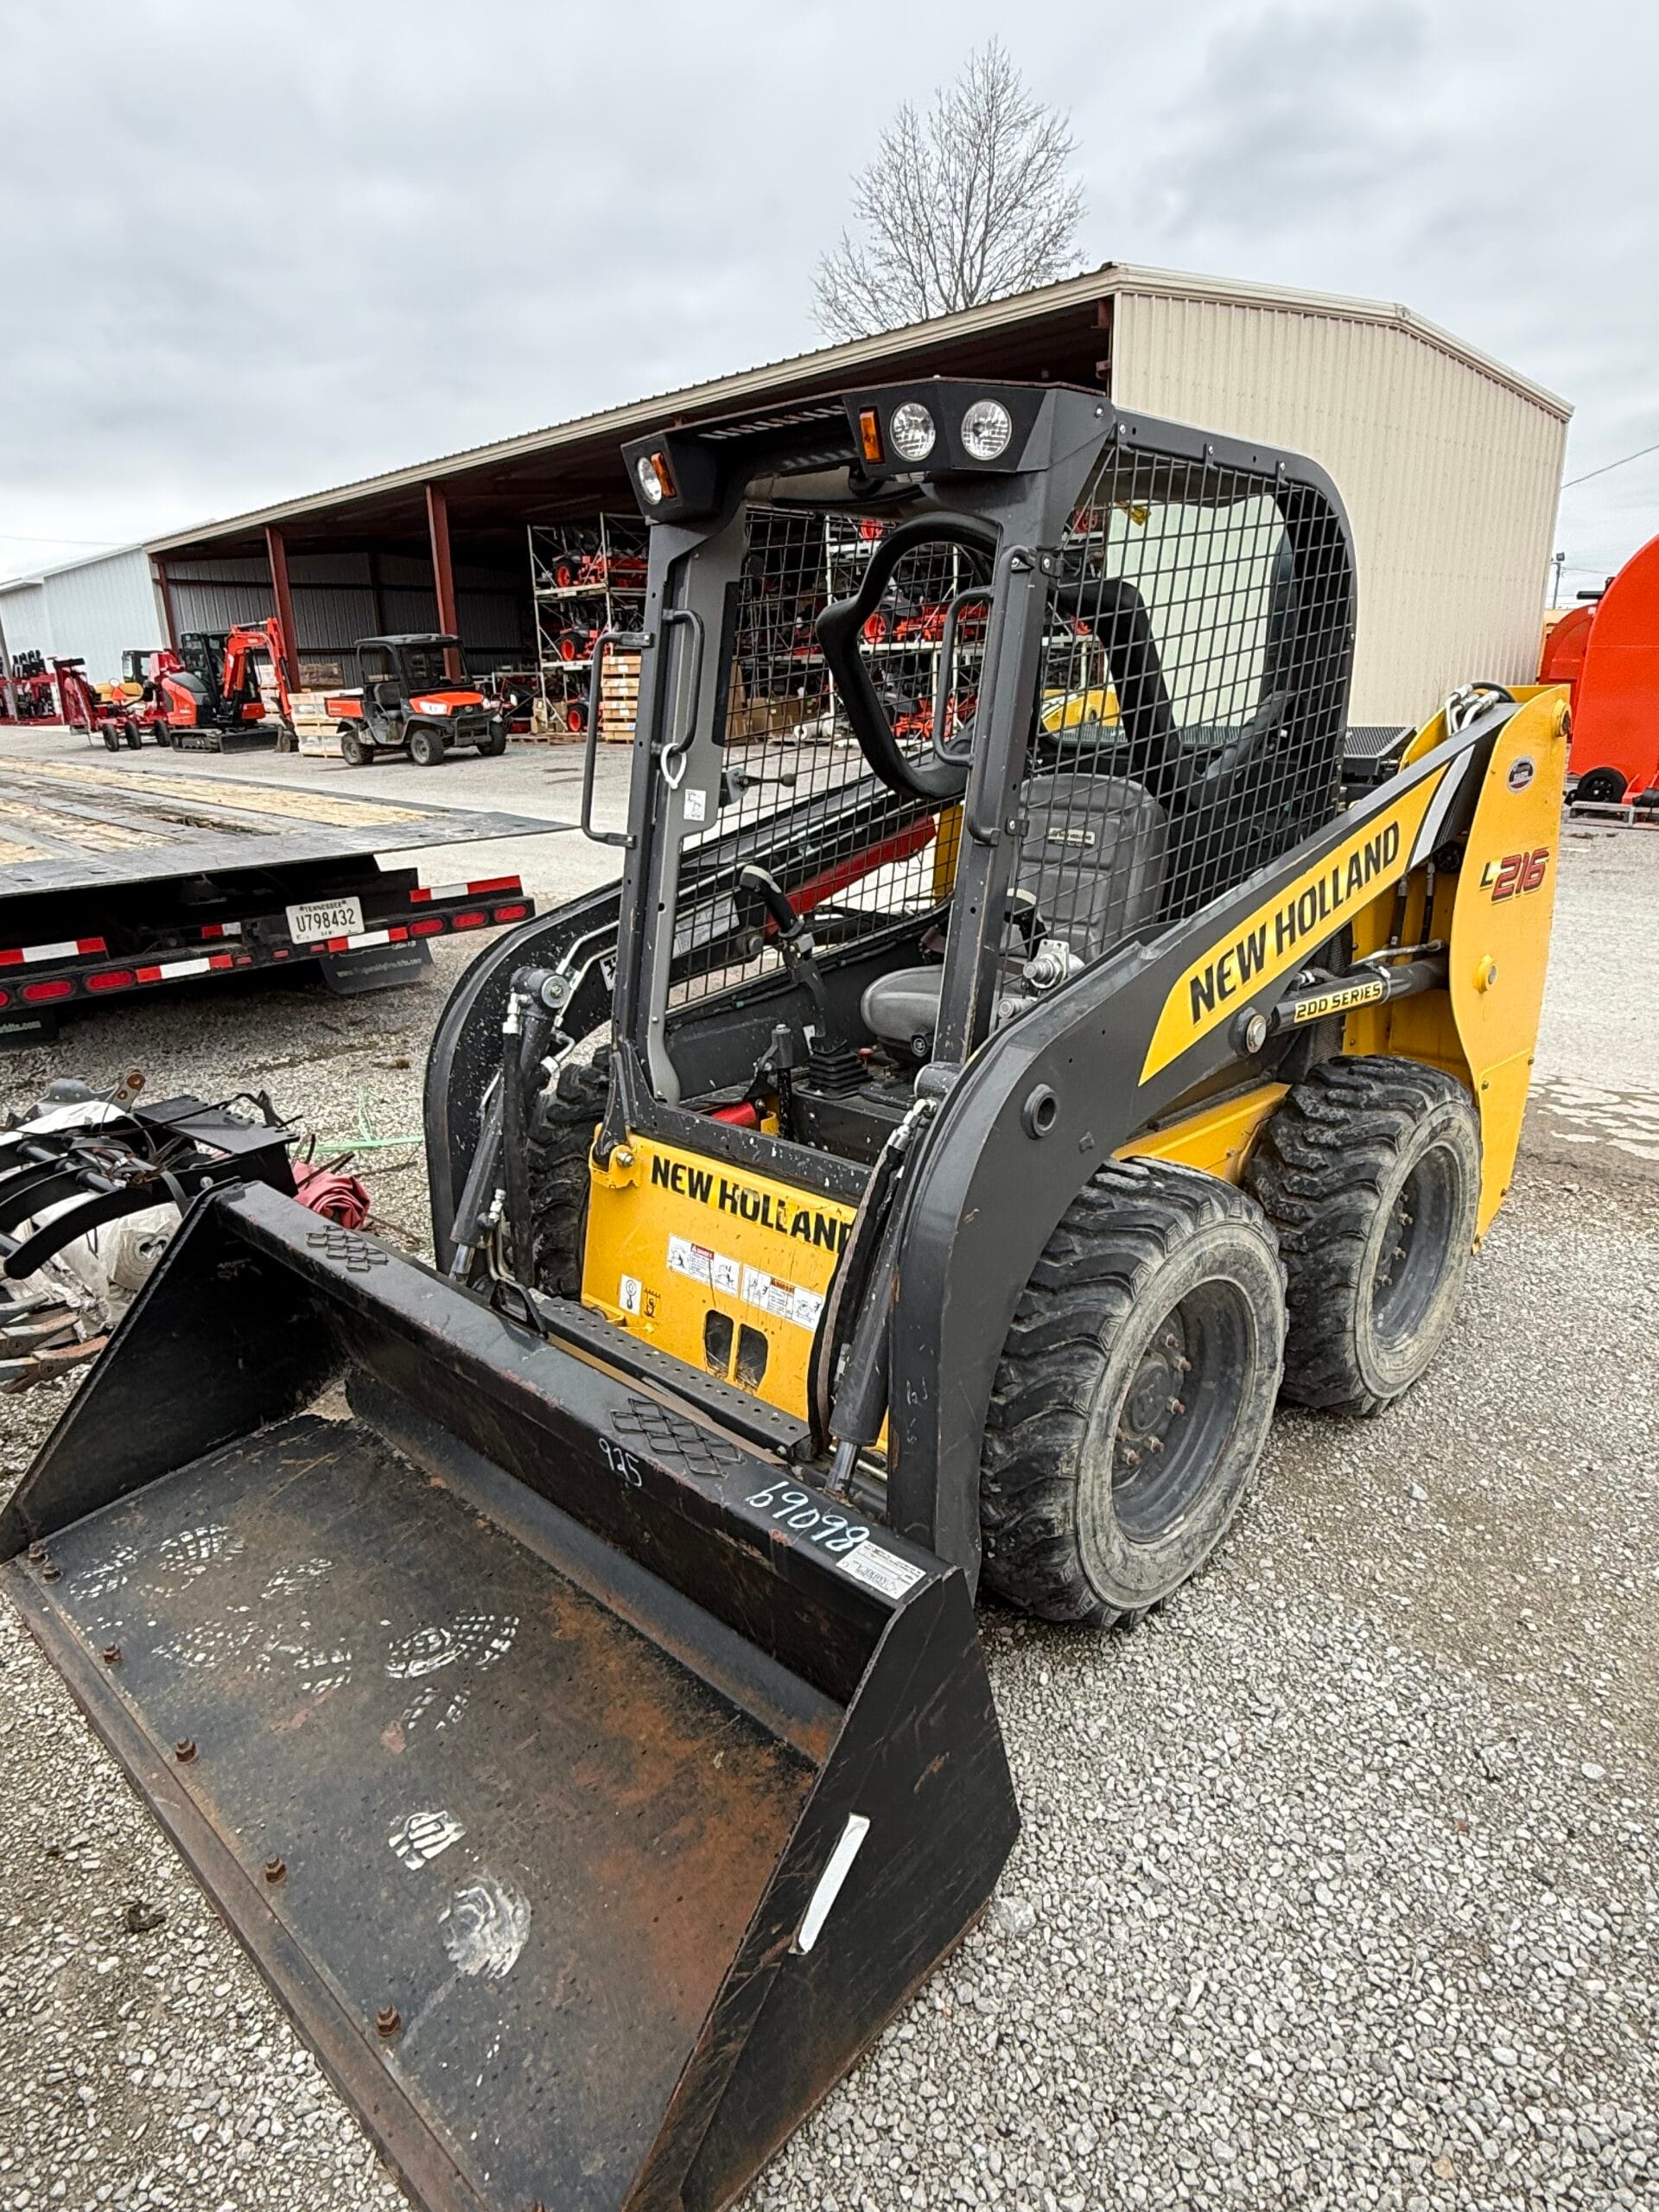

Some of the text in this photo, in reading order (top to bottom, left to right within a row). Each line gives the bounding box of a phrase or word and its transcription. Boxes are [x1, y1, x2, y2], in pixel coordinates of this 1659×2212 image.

[1479, 847, 1549, 902] L216
[296, 908, 356, 932] U798432
[304, 901, 342, 912] TENNESSEE
[1190, 821, 1400, 1025] NEW HOLLAND
[1297, 983, 1381, 1019] 200 SERIES
[651, 1154, 713, 1204] NEW
[745, 1480, 871, 1553] 69098
